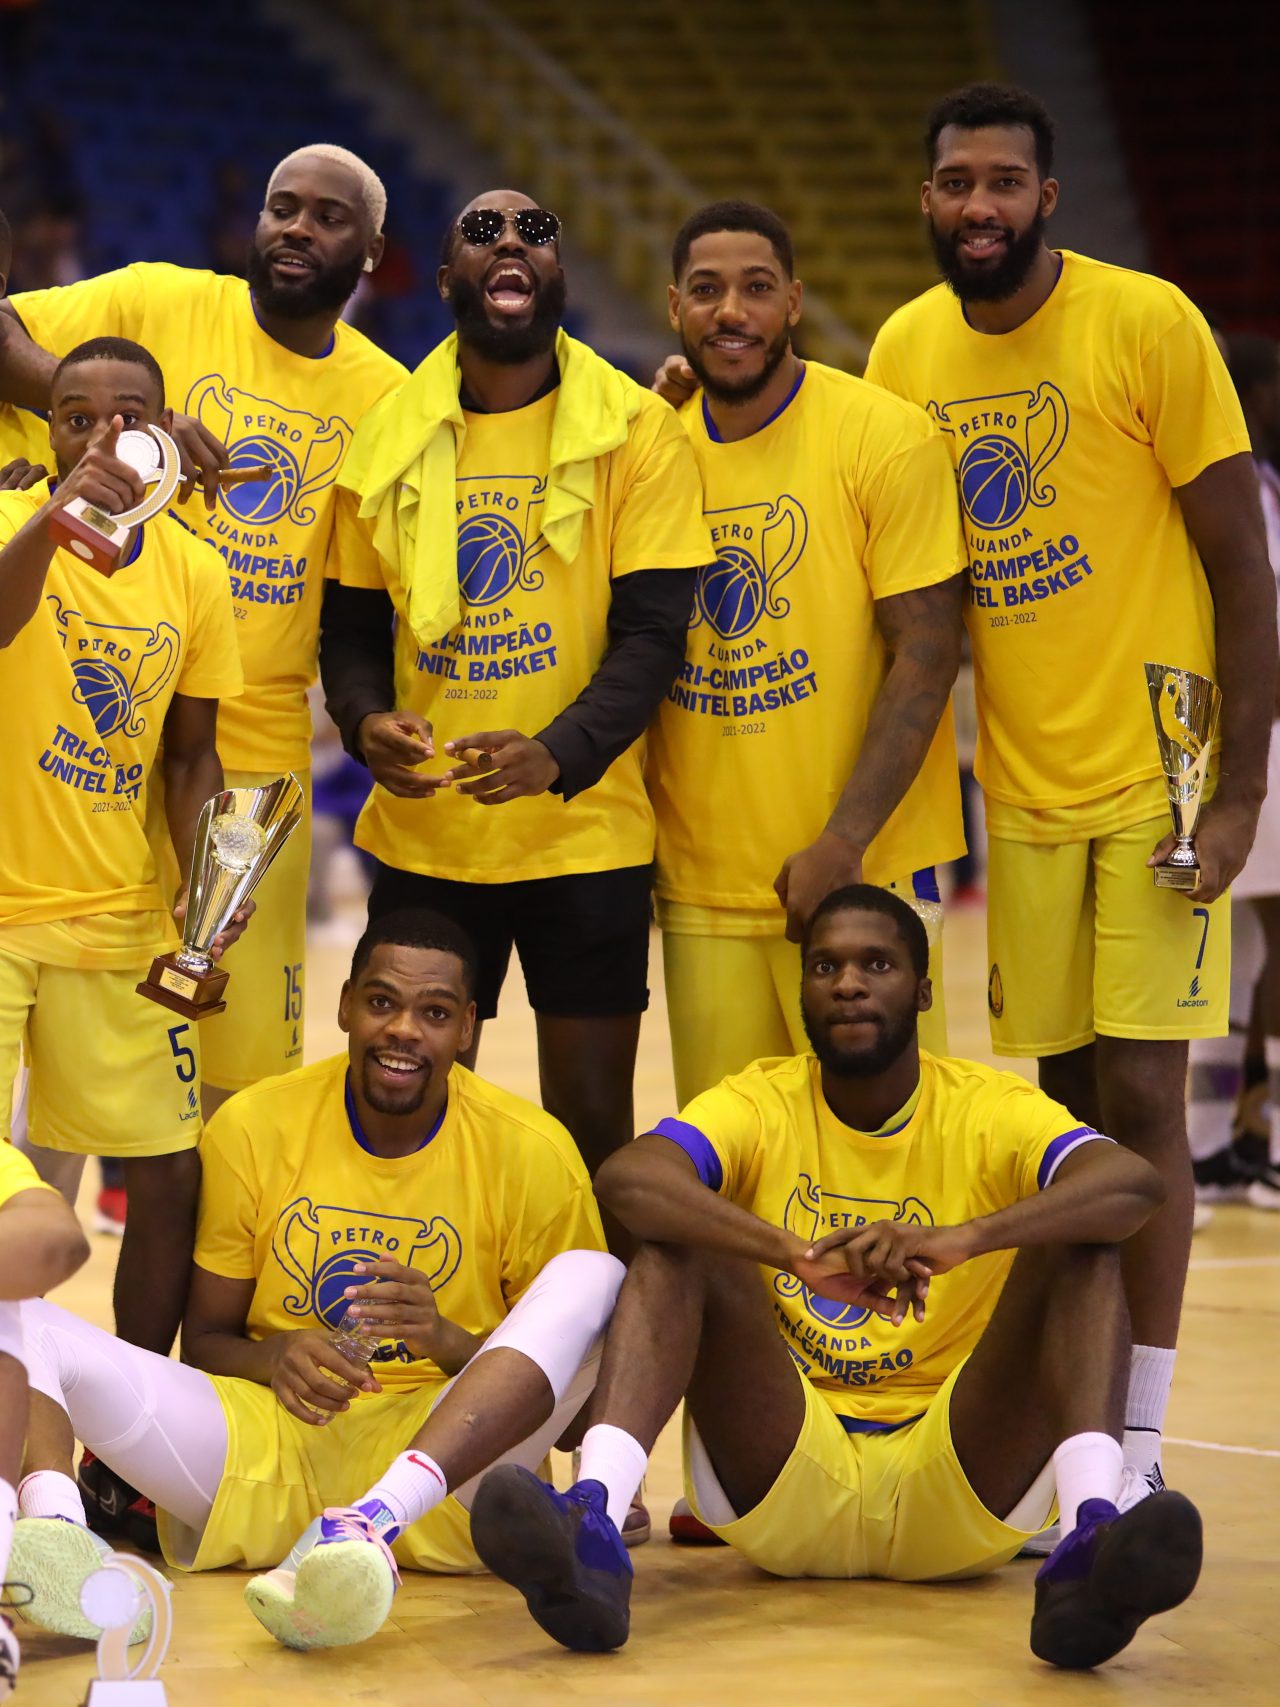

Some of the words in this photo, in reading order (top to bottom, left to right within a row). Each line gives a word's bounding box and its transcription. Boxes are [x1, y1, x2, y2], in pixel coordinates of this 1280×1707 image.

[244, 414, 303, 443] PETRO
[959, 411, 1017, 438] PETRO
[456, 491, 519, 515] PETRO
[206, 513, 279, 548] LUANDA
[711, 523, 753, 542] ETRO
[970, 526, 1034, 554] LUANDA
[230, 576, 305, 605] BASKET
[1003, 554, 1094, 607] BASKET
[989, 612, 1037, 628] 2021-2022
[468, 646, 558, 682] BASKET
[708, 638, 767, 663] LUANDA
[678, 648, 809, 692] RI-CAMPEÃO
[444, 689, 498, 700] 2021-2022
[733, 671, 819, 717] BASKET
[722, 723, 767, 737] 2021-2022
[38, 749, 107, 793] UNITEL
[1193, 908, 1210, 969] 7
[284, 963, 302, 1021] 15
[167, 1023, 196, 1083] 5
[331, 1227, 400, 1251] PETRO
[796, 1318, 872, 1352] LUANDA
